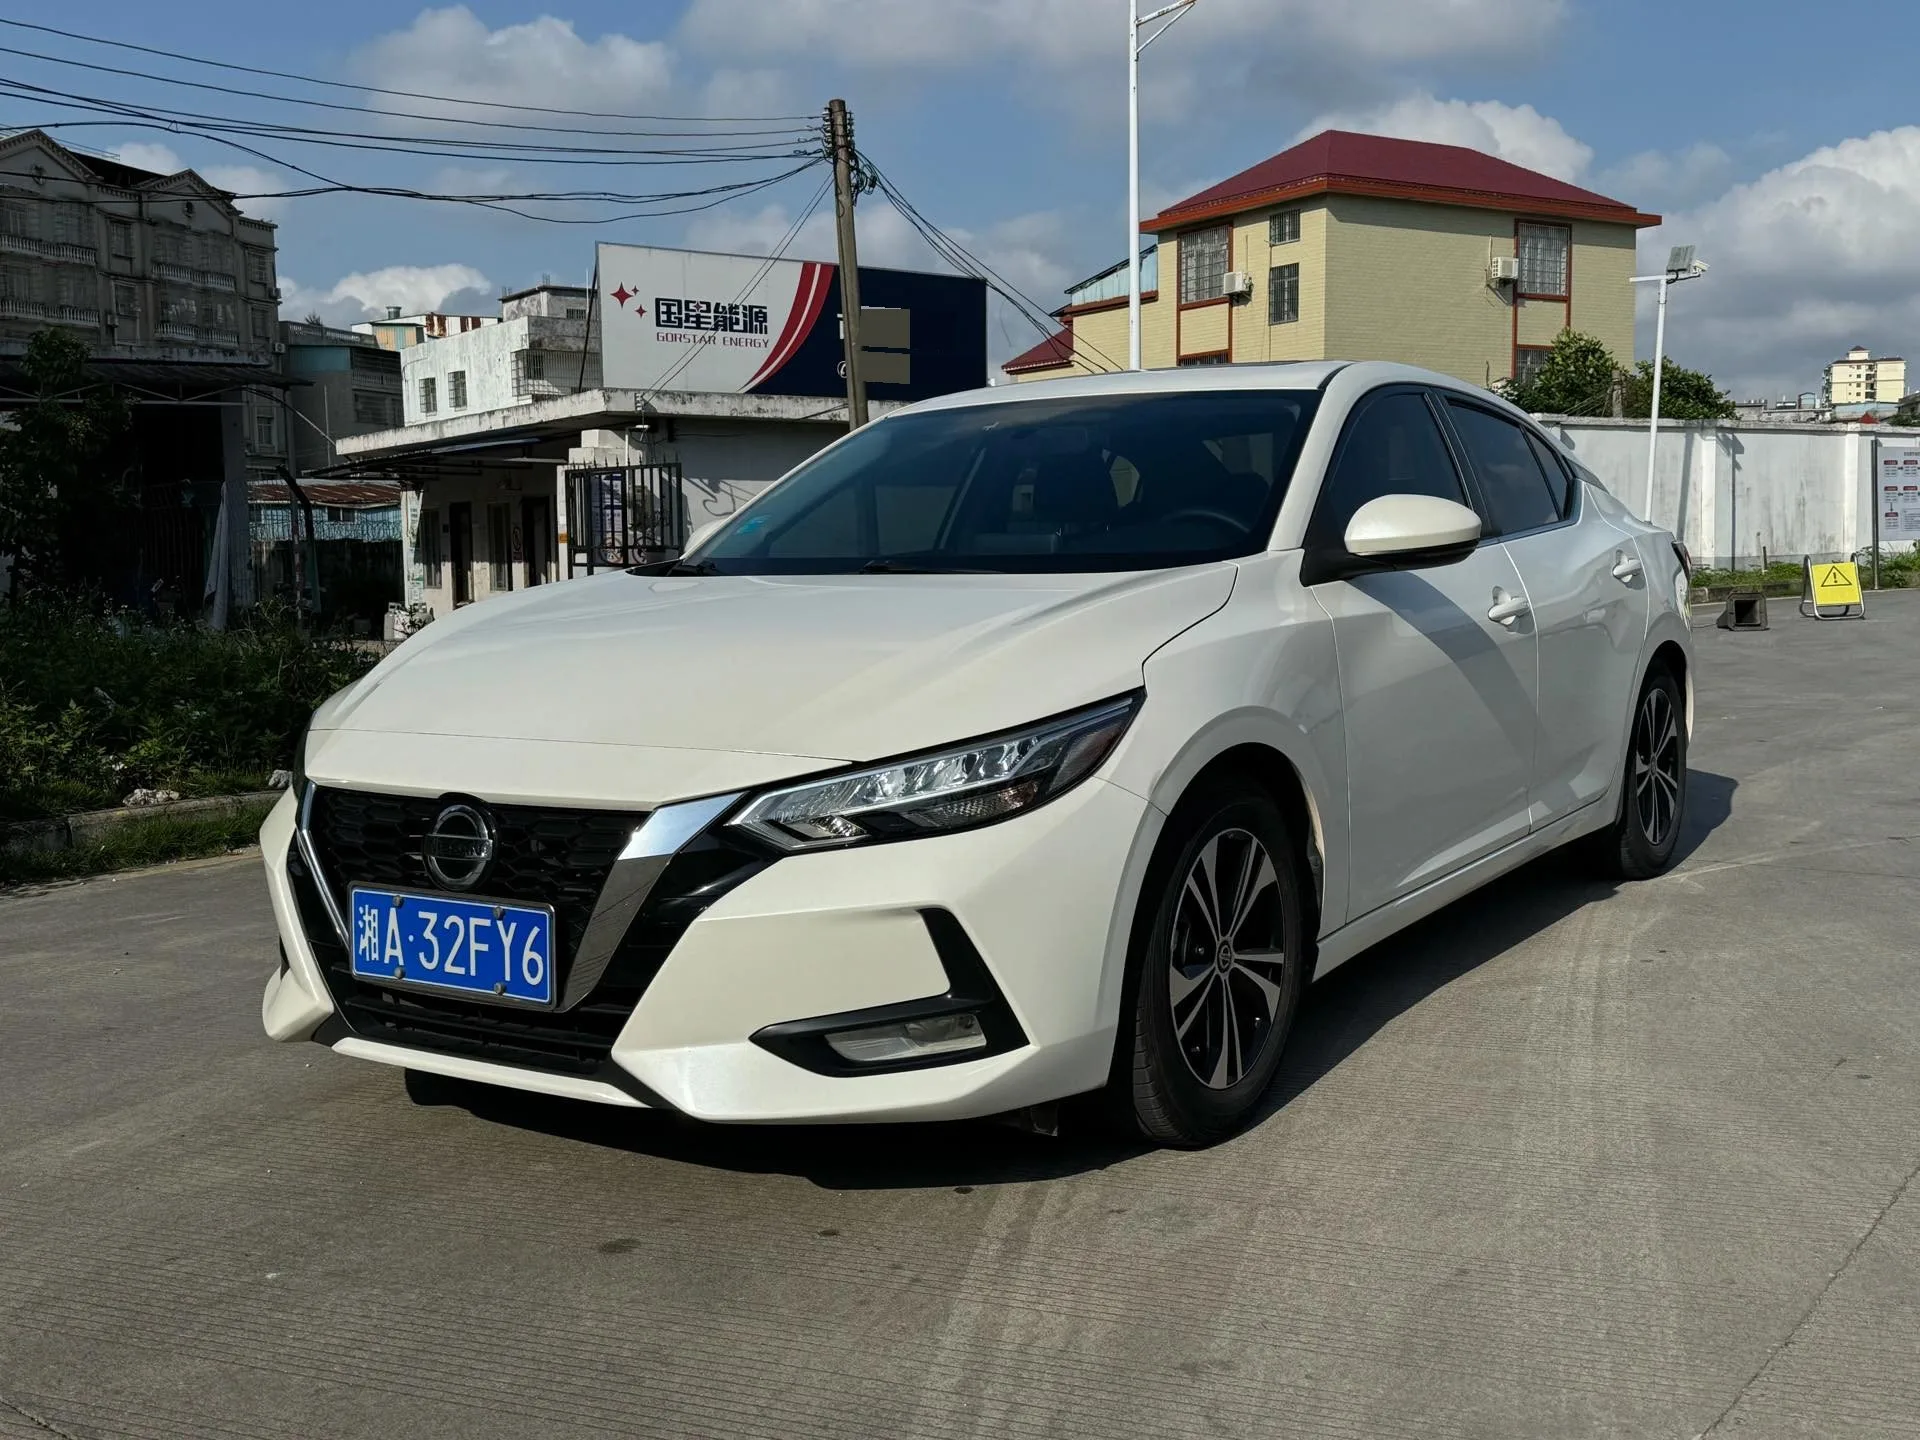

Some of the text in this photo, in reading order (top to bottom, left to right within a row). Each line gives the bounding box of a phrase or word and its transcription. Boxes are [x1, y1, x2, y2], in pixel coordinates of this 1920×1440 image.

[655, 297, 768, 335] 国星能源
[656, 332, 770, 348] GORSTAR ENERGY
